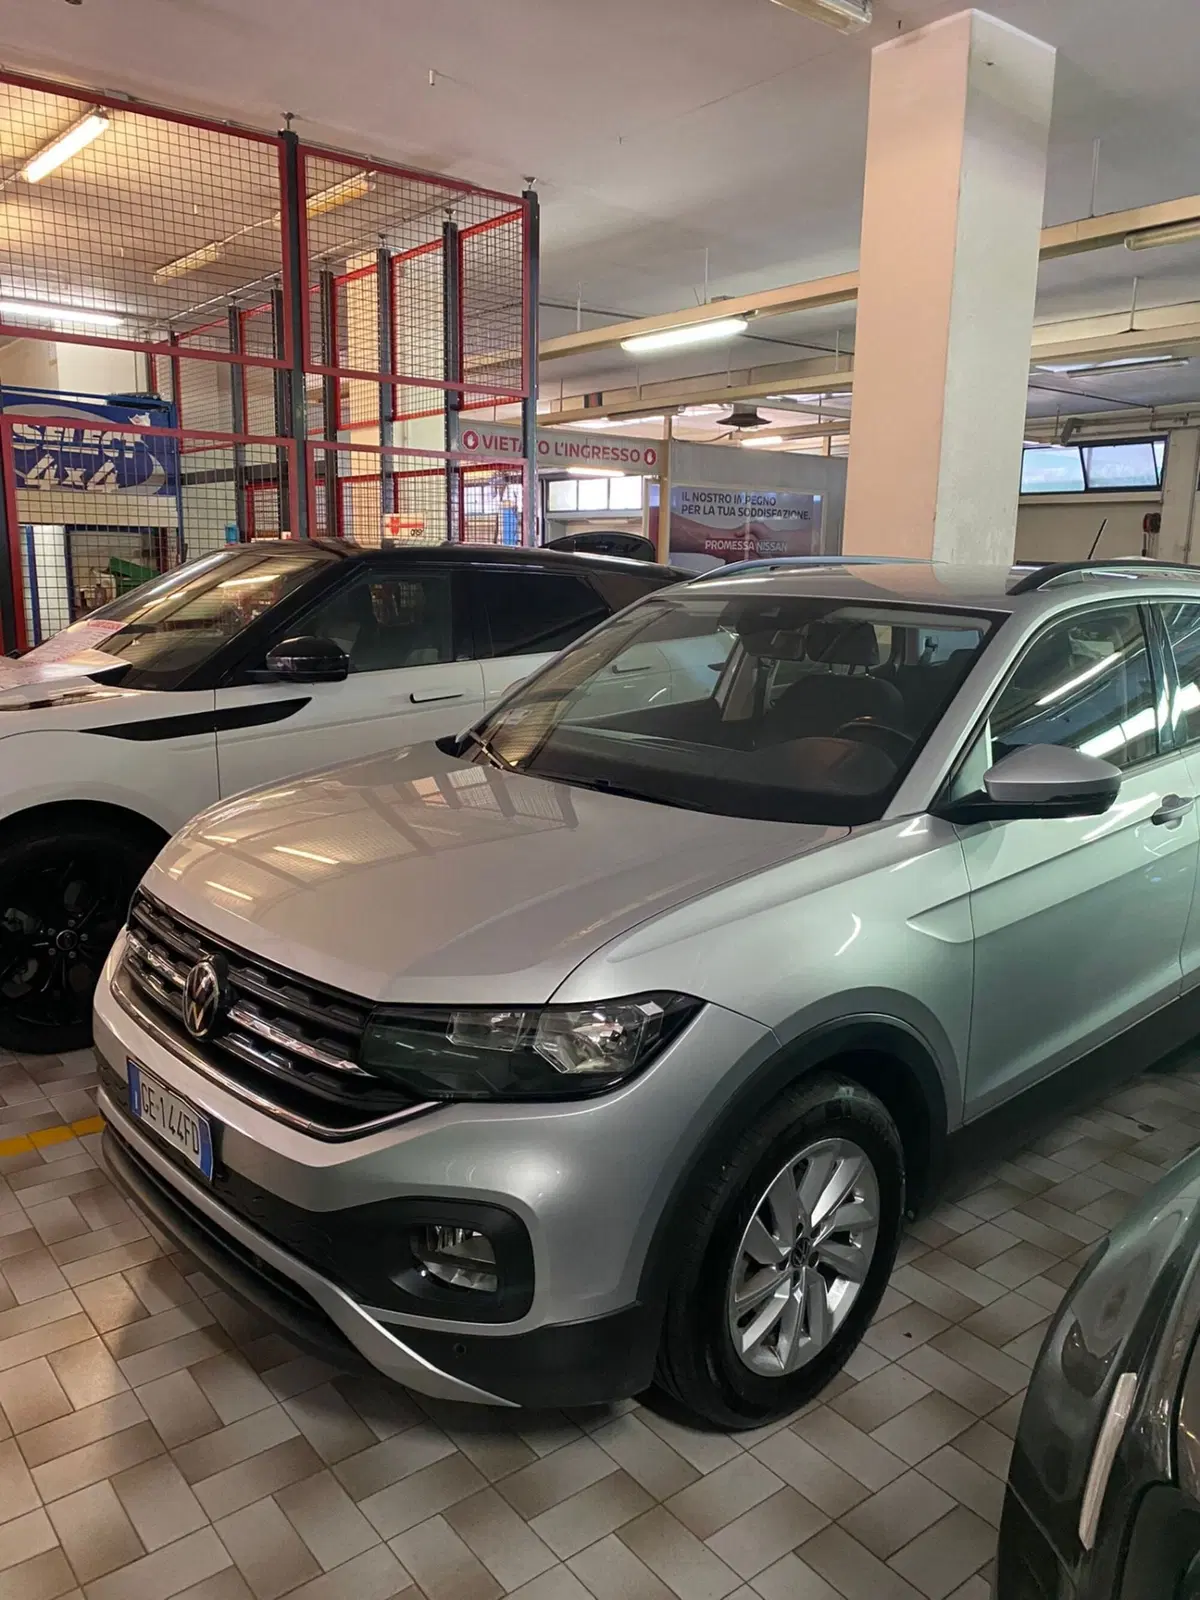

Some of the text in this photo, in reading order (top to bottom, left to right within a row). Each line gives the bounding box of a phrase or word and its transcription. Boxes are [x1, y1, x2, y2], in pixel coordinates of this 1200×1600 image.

[482, 434, 641, 463] VIETO L'INGRESSO
[681, 491, 691, 502] IL
[692, 491, 732, 504] NOSTRO
[681, 504, 701, 515] PER
[703, 505, 717, 516] LA
[717, 506, 736, 517] TUA
[704, 539, 789, 552] PROMESSA NISSAN
[160, 1096, 200, 1156] 144FD
